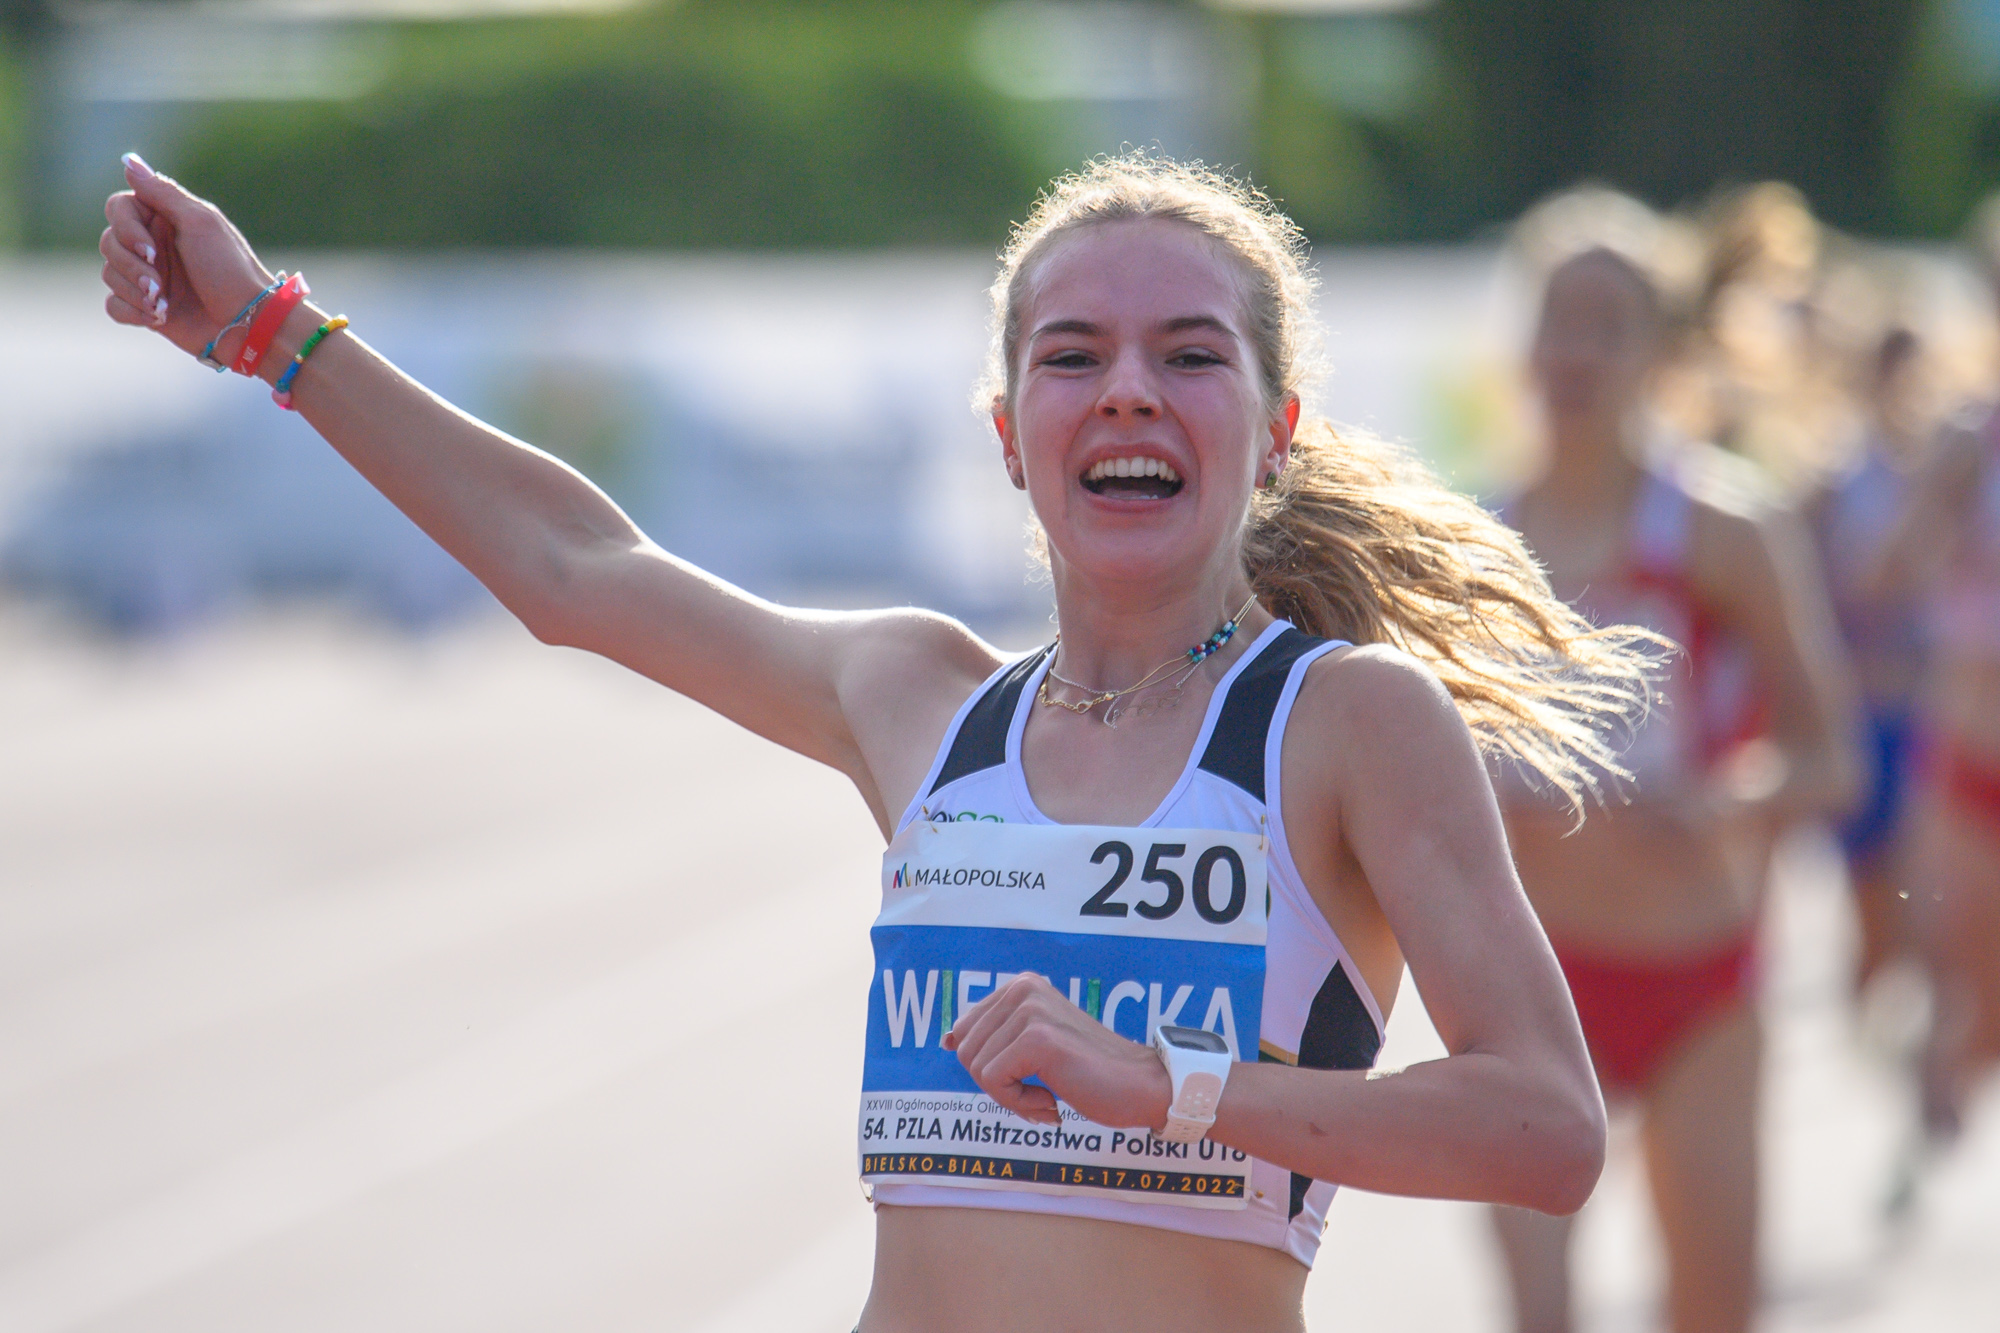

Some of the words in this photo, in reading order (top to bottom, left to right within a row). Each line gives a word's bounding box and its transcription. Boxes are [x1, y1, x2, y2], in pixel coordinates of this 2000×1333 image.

[914, 868, 1046, 890] MAŁOPOLSKA
[1079, 840, 1247, 925] 250
[865, 1099, 893, 1111] XXVIII
[895, 1098, 973, 1114] Ogólnopolska
[863, 1117, 889, 1140] 54.
[895, 1117, 943, 1140] PZLA
[950, 1119, 1102, 1152] Mistrzostwa
[1111, 1131, 1188, 1159] Polski
[864, 1156, 1014, 1178] BIELSKO-BIAŁA
[1060, 1166, 1236, 1195] 15-17.07.2022
